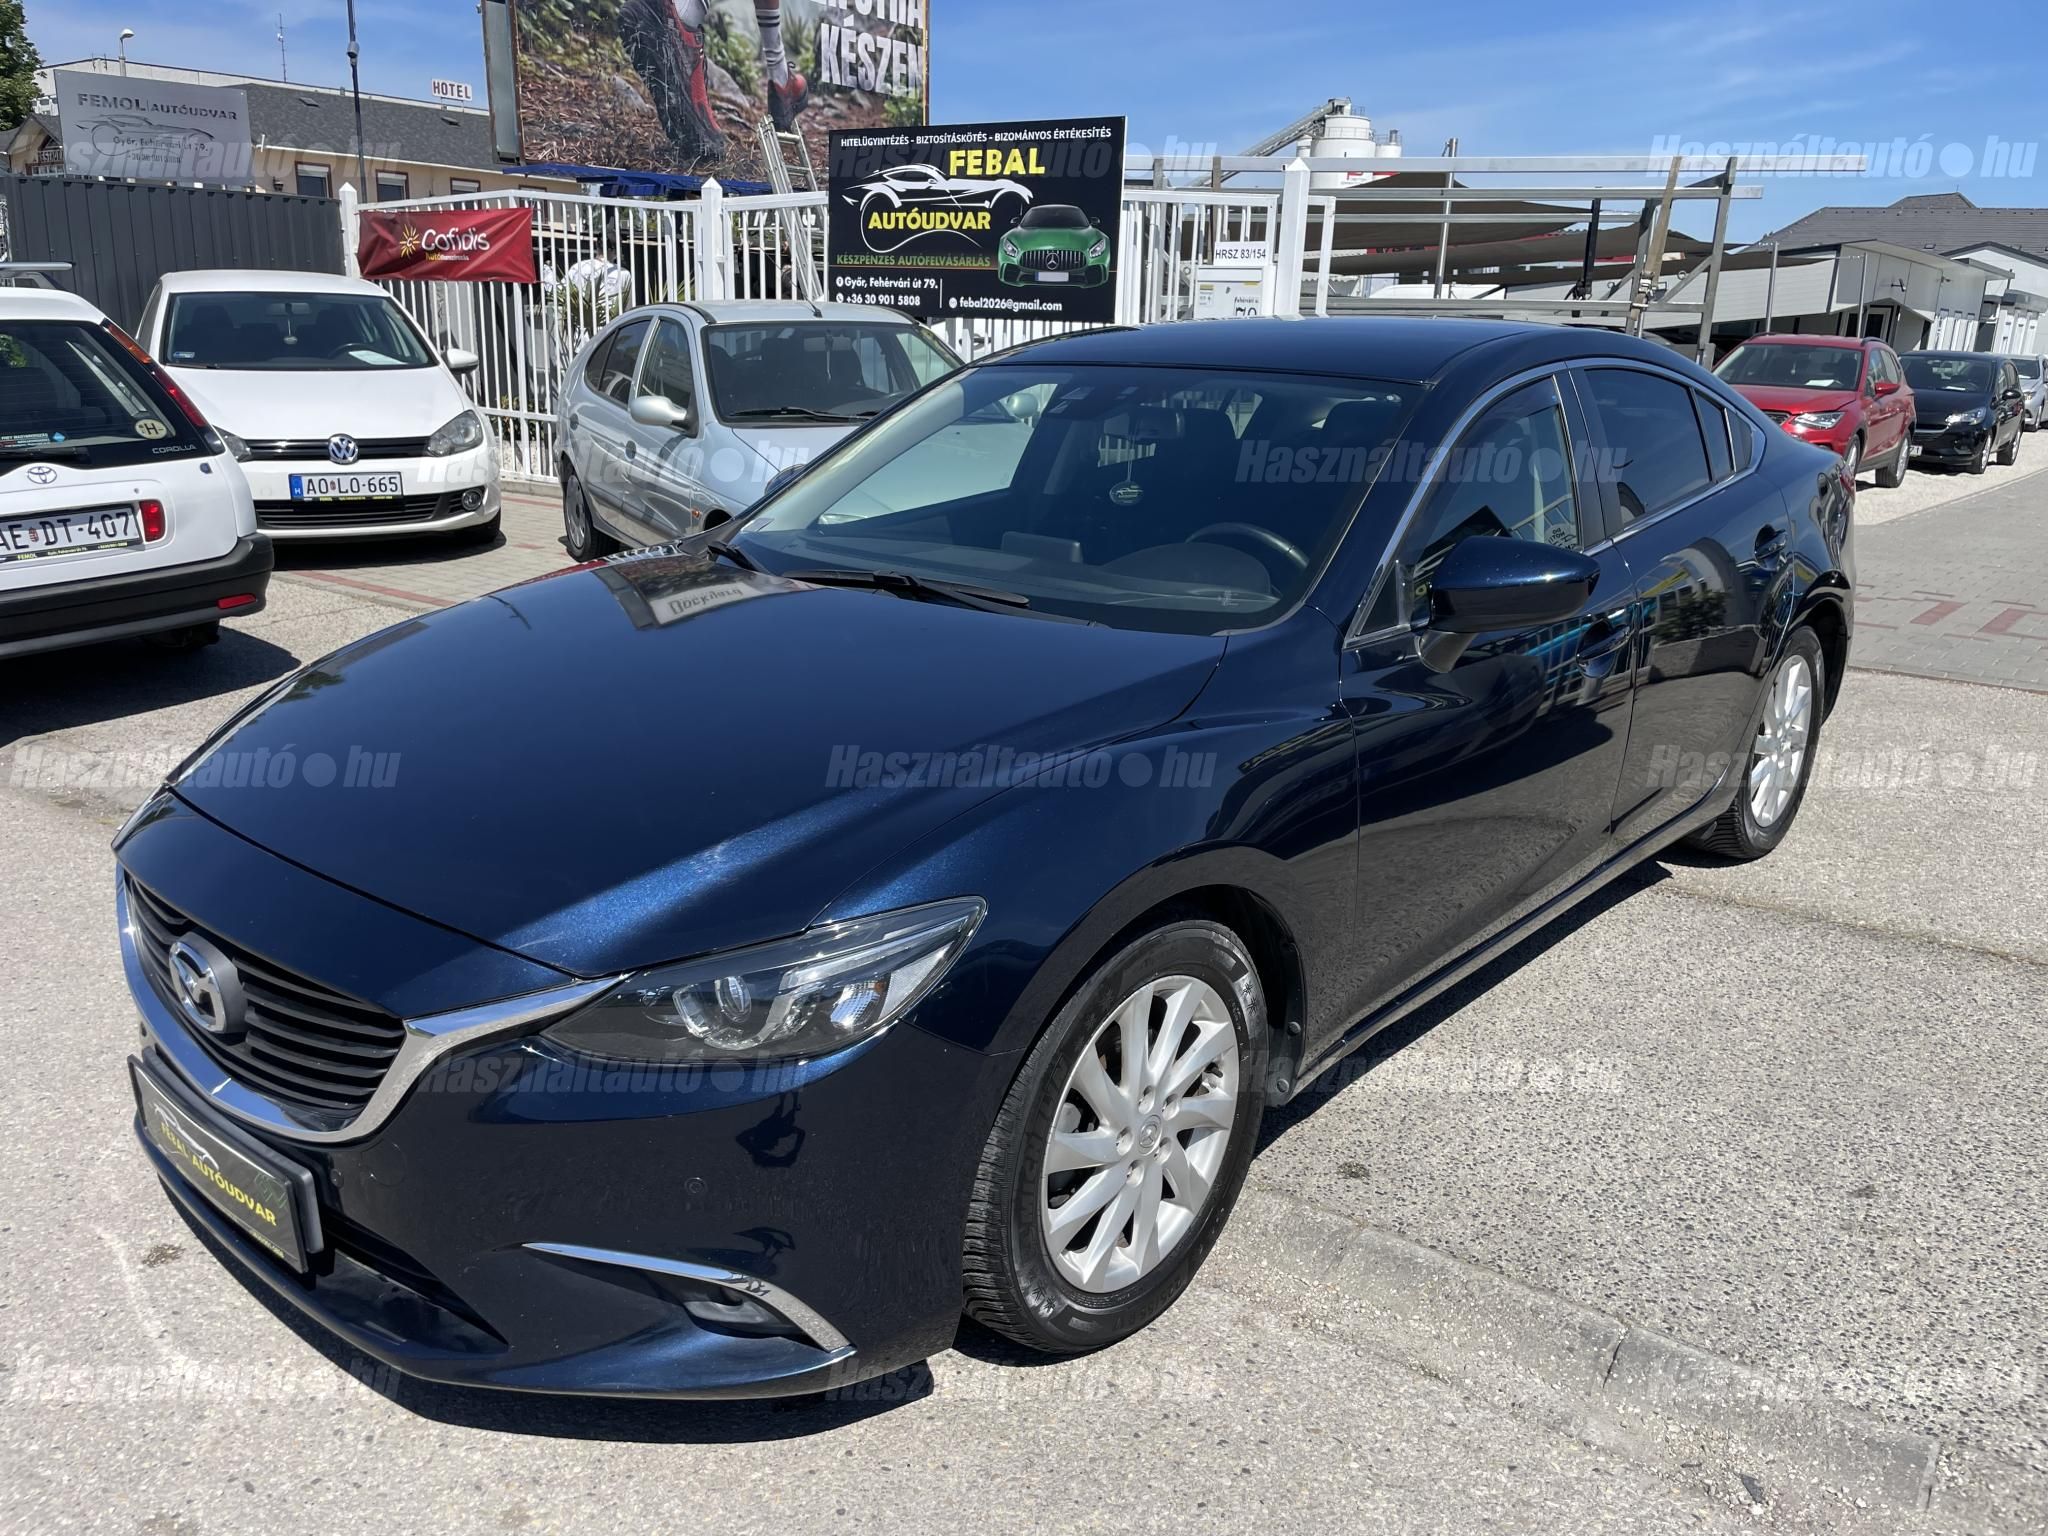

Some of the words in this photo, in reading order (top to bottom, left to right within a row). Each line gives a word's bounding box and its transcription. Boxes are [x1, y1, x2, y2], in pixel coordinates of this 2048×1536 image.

[820, 15, 923, 100] KÉSZEN
[433, 81, 471, 99] HOTEL
[77, 93, 147, 111] FEMOL
[151, 104, 238, 121] AUTÓUDVAR
[841, 136, 909, 147] HITELÜGYINTÉZÉS
[916, 132, 987, 145] BIZTOSÍTÁSKÖTÉS
[995, 130, 1052, 142] BIZOMÁNYOS
[1053, 128, 1111, 140] ÉRTÉKESÍTÉS
[950, 147, 1045, 176] FEBAL
[868, 207, 991, 230] AUTÓUDVAR
[422, 228, 490, 251] Cofidis
[836, 254, 895, 266] KÉSZPÉNZES
[899, 253, 991, 267] AUTÓFELVÁSÁRLÁS
[1216, 249, 1238, 259] HRSZ
[845, 276, 868, 289] Győr,
[869, 277, 911, 288] Fehérvári
[913, 279, 922, 289] út
[924, 279, 938, 289] 79.
[846, 295, 863, 305] +36
[865, 295, 876, 305] 30
[877, 295, 895, 306] 901
[897, 295, 920, 306] 5808
[959, 297, 1063, 312] febal2026@gmail.com
[152, 444, 197, 454] COROLLA
[192, 1153, 277, 1227] AUTÓUDVAR
